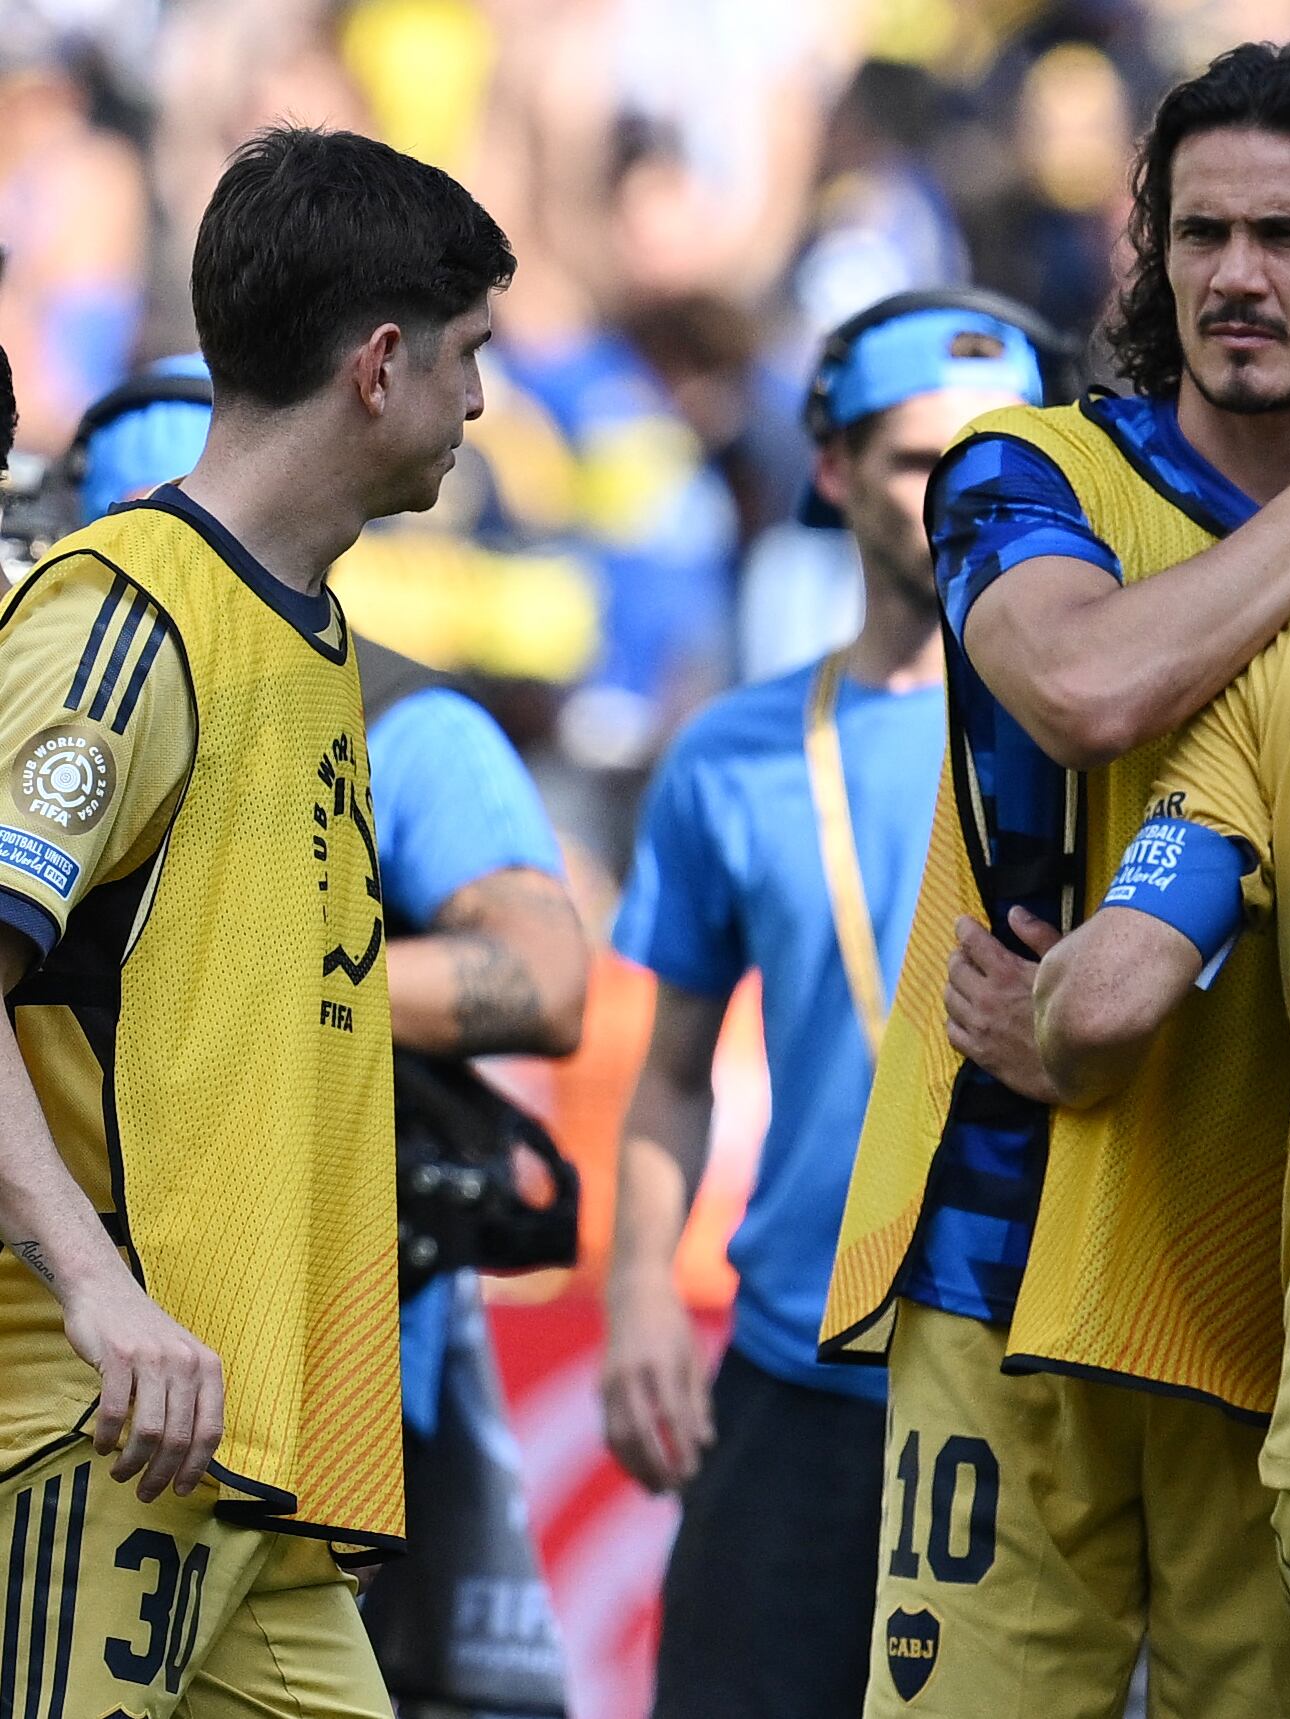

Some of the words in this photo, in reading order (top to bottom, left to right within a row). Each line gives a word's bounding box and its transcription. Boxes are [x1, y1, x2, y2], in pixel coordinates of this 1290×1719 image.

[34, 736, 86, 758] WORLD
[88, 746, 107, 774] CUP
[23, 760, 37, 795] CLUB
[96, 779, 107, 797] 25
[29, 798, 68, 827] FIFA
[77, 799, 99, 821] USA
[9, 847, 47, 875] World
[44, 847, 74, 876] UNITES
[320, 999, 353, 1033] FIFA
[889, 1430, 999, 1585] 10
[104, 1528, 211, 1694] 30
[889, 1636, 935, 1660] CABJ
